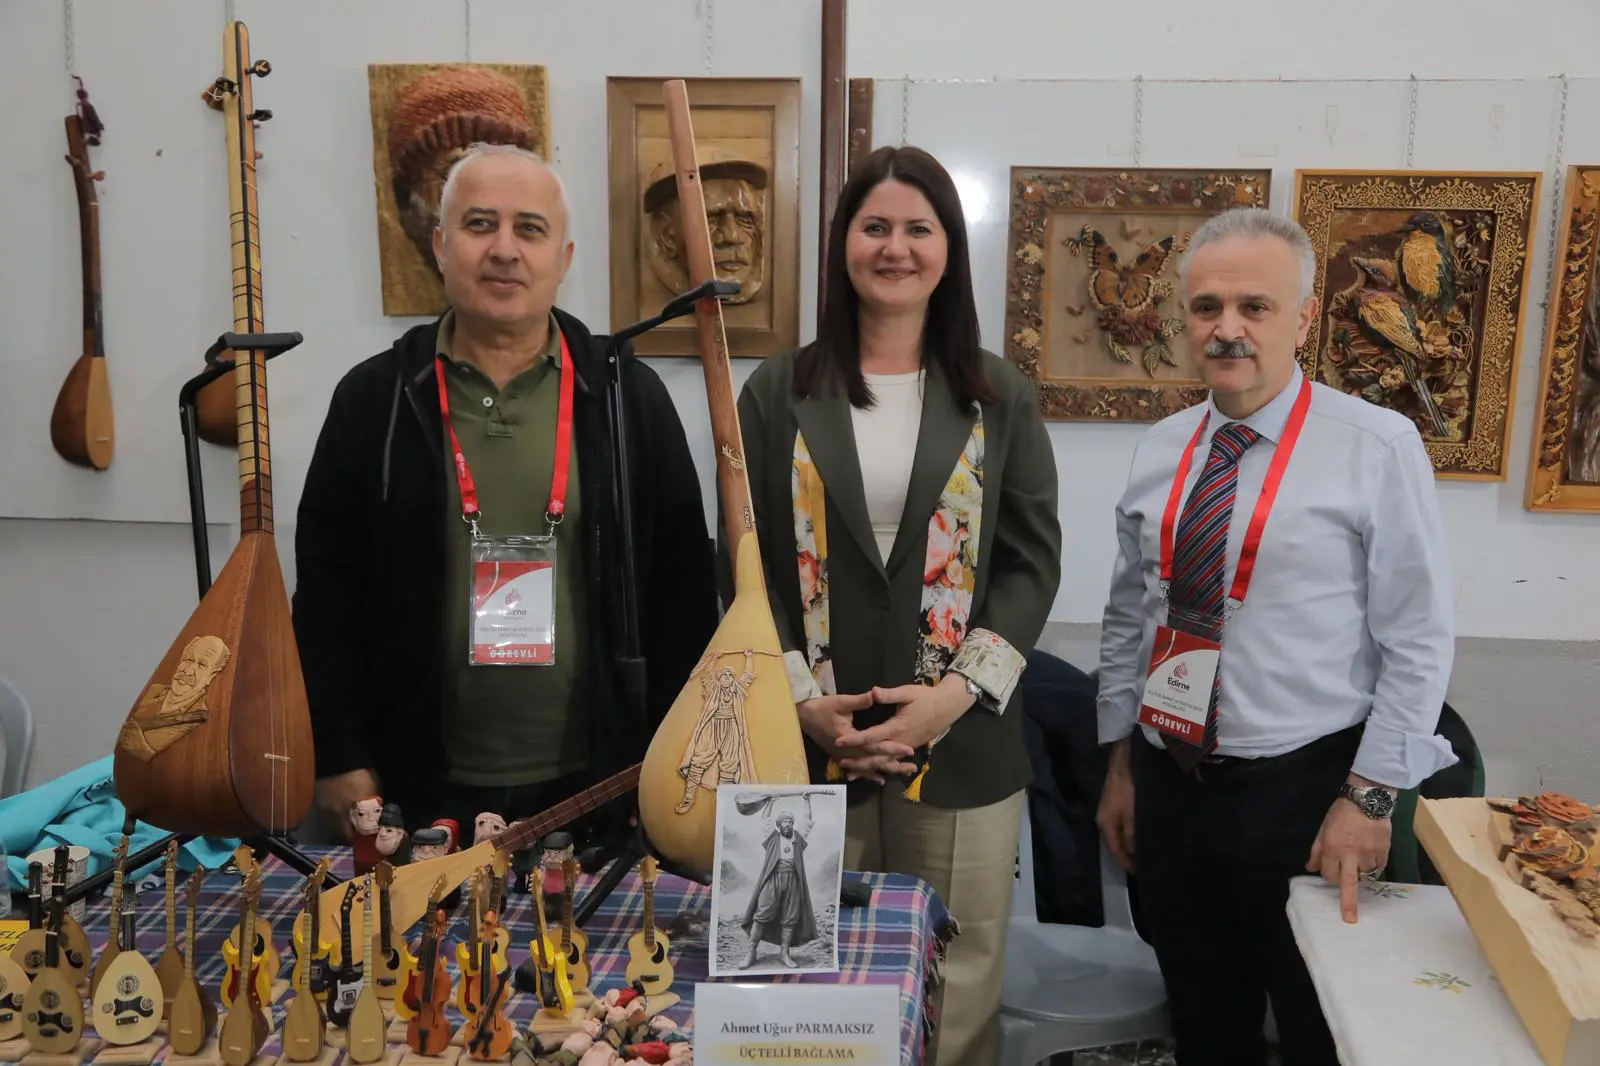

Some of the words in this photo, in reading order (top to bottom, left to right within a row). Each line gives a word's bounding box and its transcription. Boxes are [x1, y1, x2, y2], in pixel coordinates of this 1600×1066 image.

[1167, 677, 1191, 691] Edirne
[1151, 714, 1191, 735] GÖREVLİ
[720, 1021, 761, 1034] Ahmet
[763, 1022, 794, 1037] Uğur
[795, 1022, 875, 1035] PARMAKSIZ
[793, 1044, 855, 1059] BAĞLAMA
